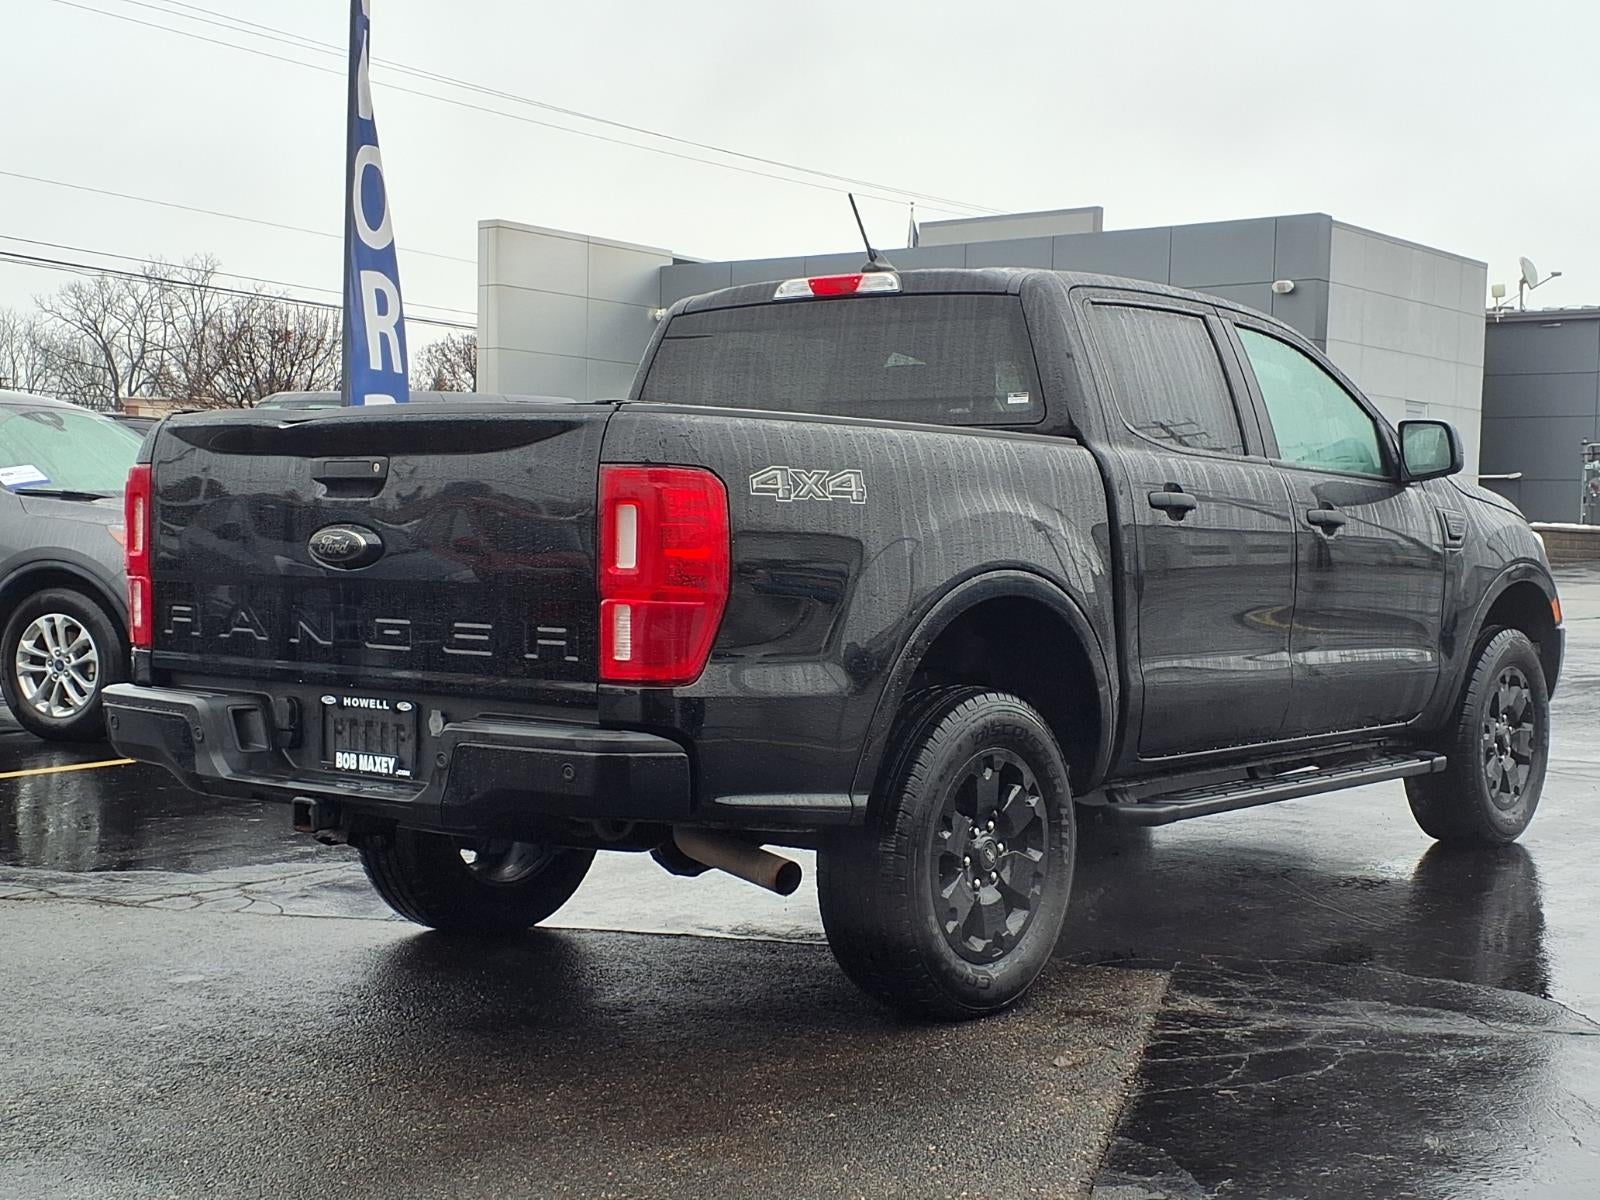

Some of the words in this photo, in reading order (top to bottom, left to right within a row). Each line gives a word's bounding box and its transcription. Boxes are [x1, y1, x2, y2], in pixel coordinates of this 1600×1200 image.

[318, 534, 350, 554] Ford
[164, 602, 579, 661] RANGER
[343, 697, 389, 710] HOWELL
[335, 752, 357, 769] BOB
[358, 754, 395, 774] MAXEY
